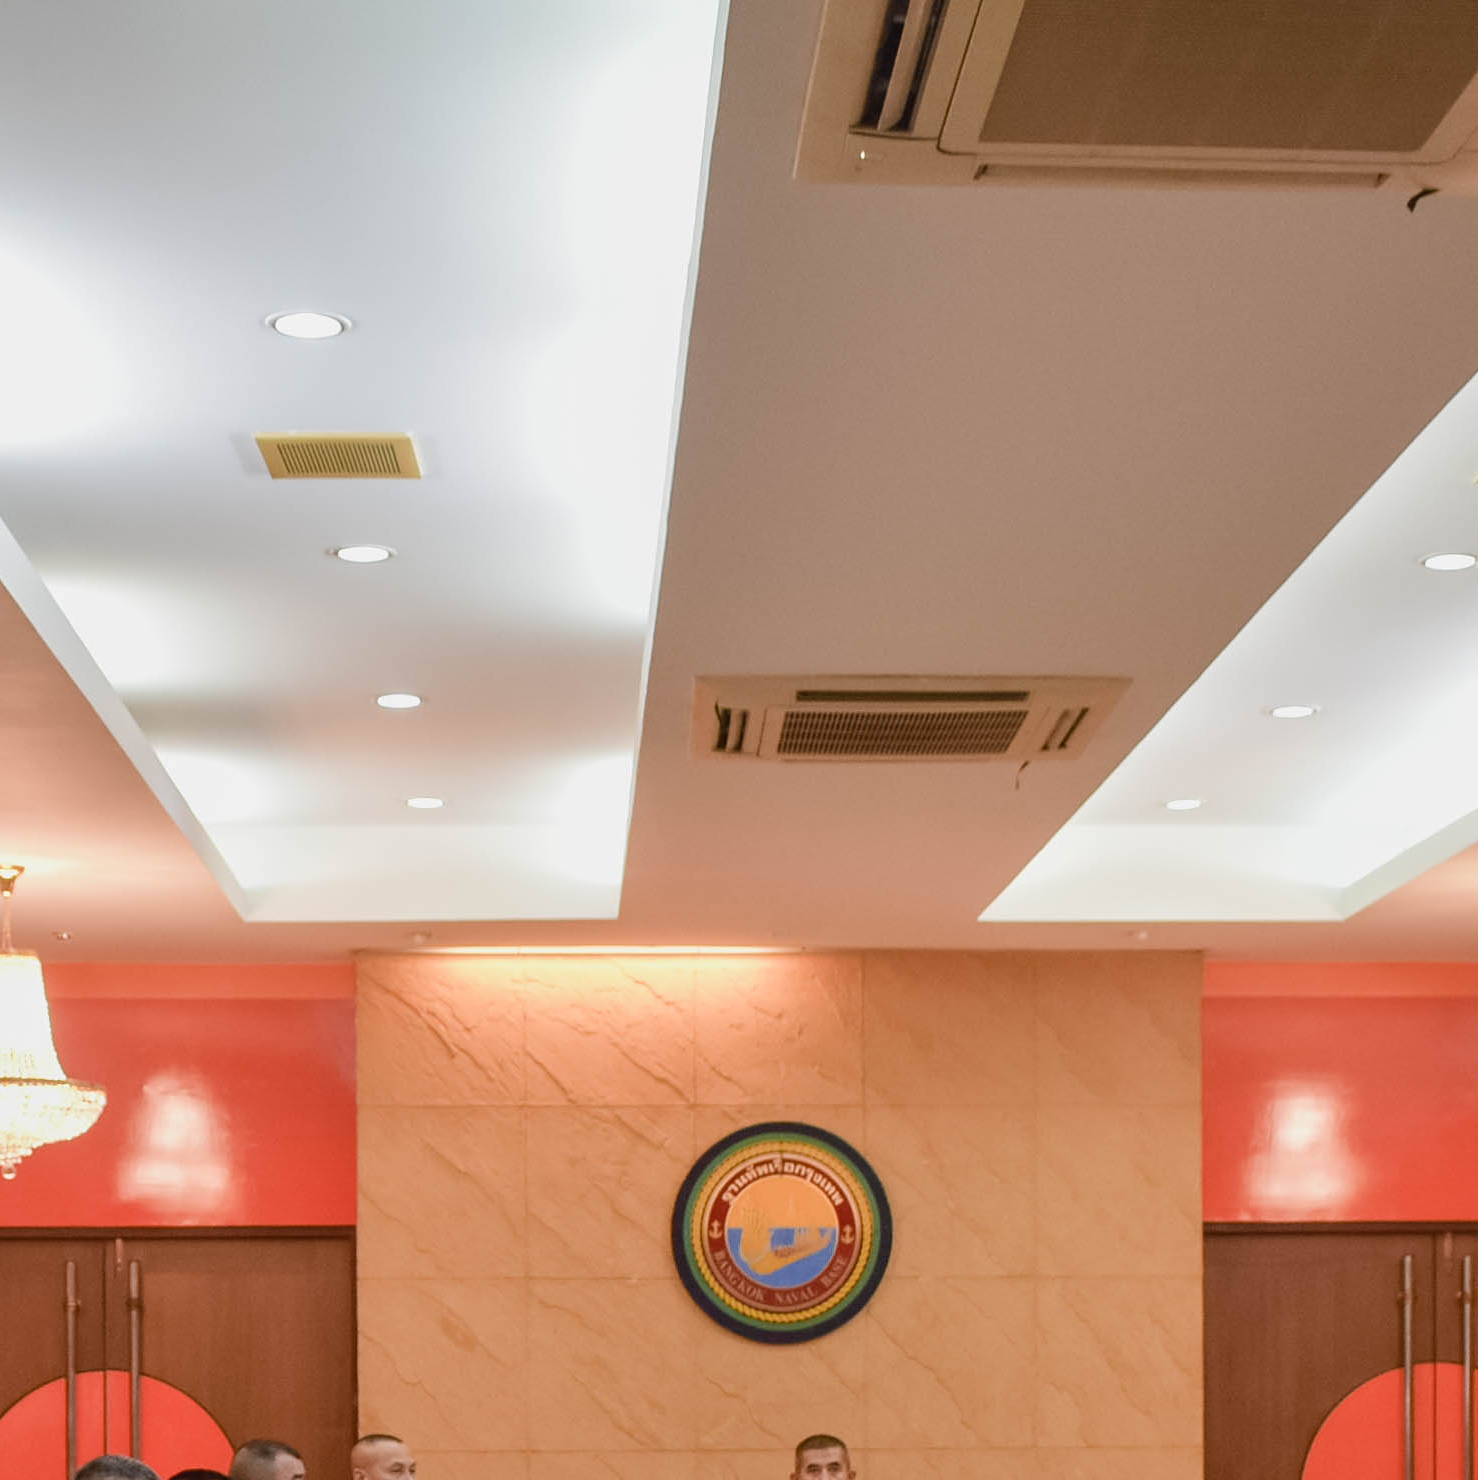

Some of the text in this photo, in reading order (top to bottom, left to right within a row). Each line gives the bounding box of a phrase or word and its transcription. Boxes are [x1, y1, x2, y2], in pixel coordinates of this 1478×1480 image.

[712, 1250, 848, 1306] BANGKOK NAVAL BASE
